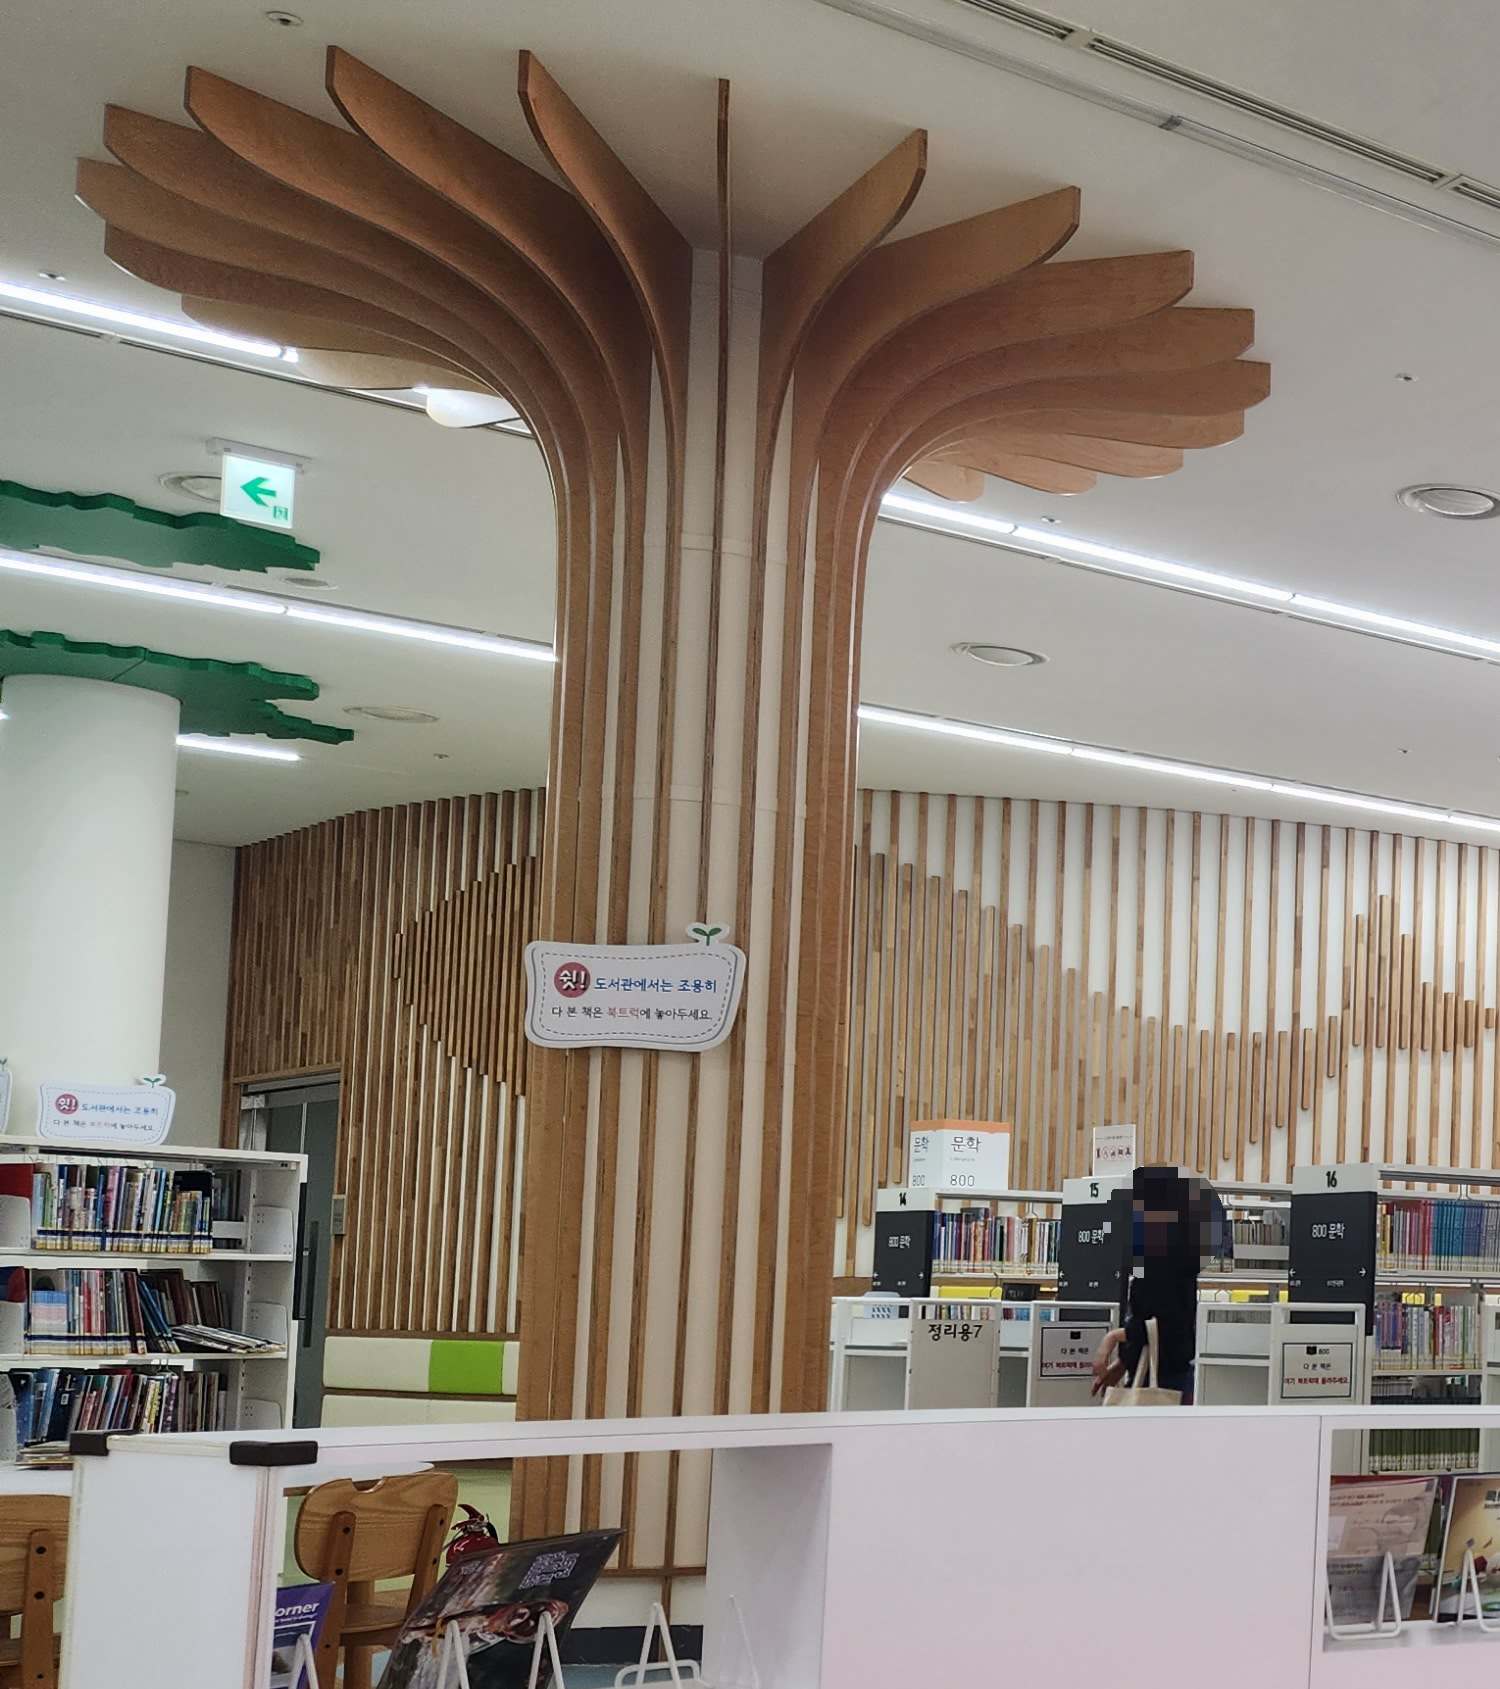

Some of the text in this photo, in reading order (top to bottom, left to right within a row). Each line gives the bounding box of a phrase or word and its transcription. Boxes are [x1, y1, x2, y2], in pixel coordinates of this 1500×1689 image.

[558, 969, 717, 994] 쉿! 도서관에서는 조용히
[551, 1006, 562, 1017] 다
[566, 1006, 578, 1017] 본
[581, 1006, 603, 1018] 책은
[607, 1006, 650, 1019] 북트럭에
[914, 1136, 929, 1153] 문학
[951, 1136, 981, 1153] 문학
[950, 1174, 975, 1187] 800
[1326, 1170, 1338, 1188] 16
[1089, 1182, 1099, 1198] 15
[1078, 1230, 1090, 1243] 800
[1312, 1222, 1345, 1240] 800 문학
[928, 1323, 983, 1341] 정리용7
[275, 1602, 320, 1617] orner
